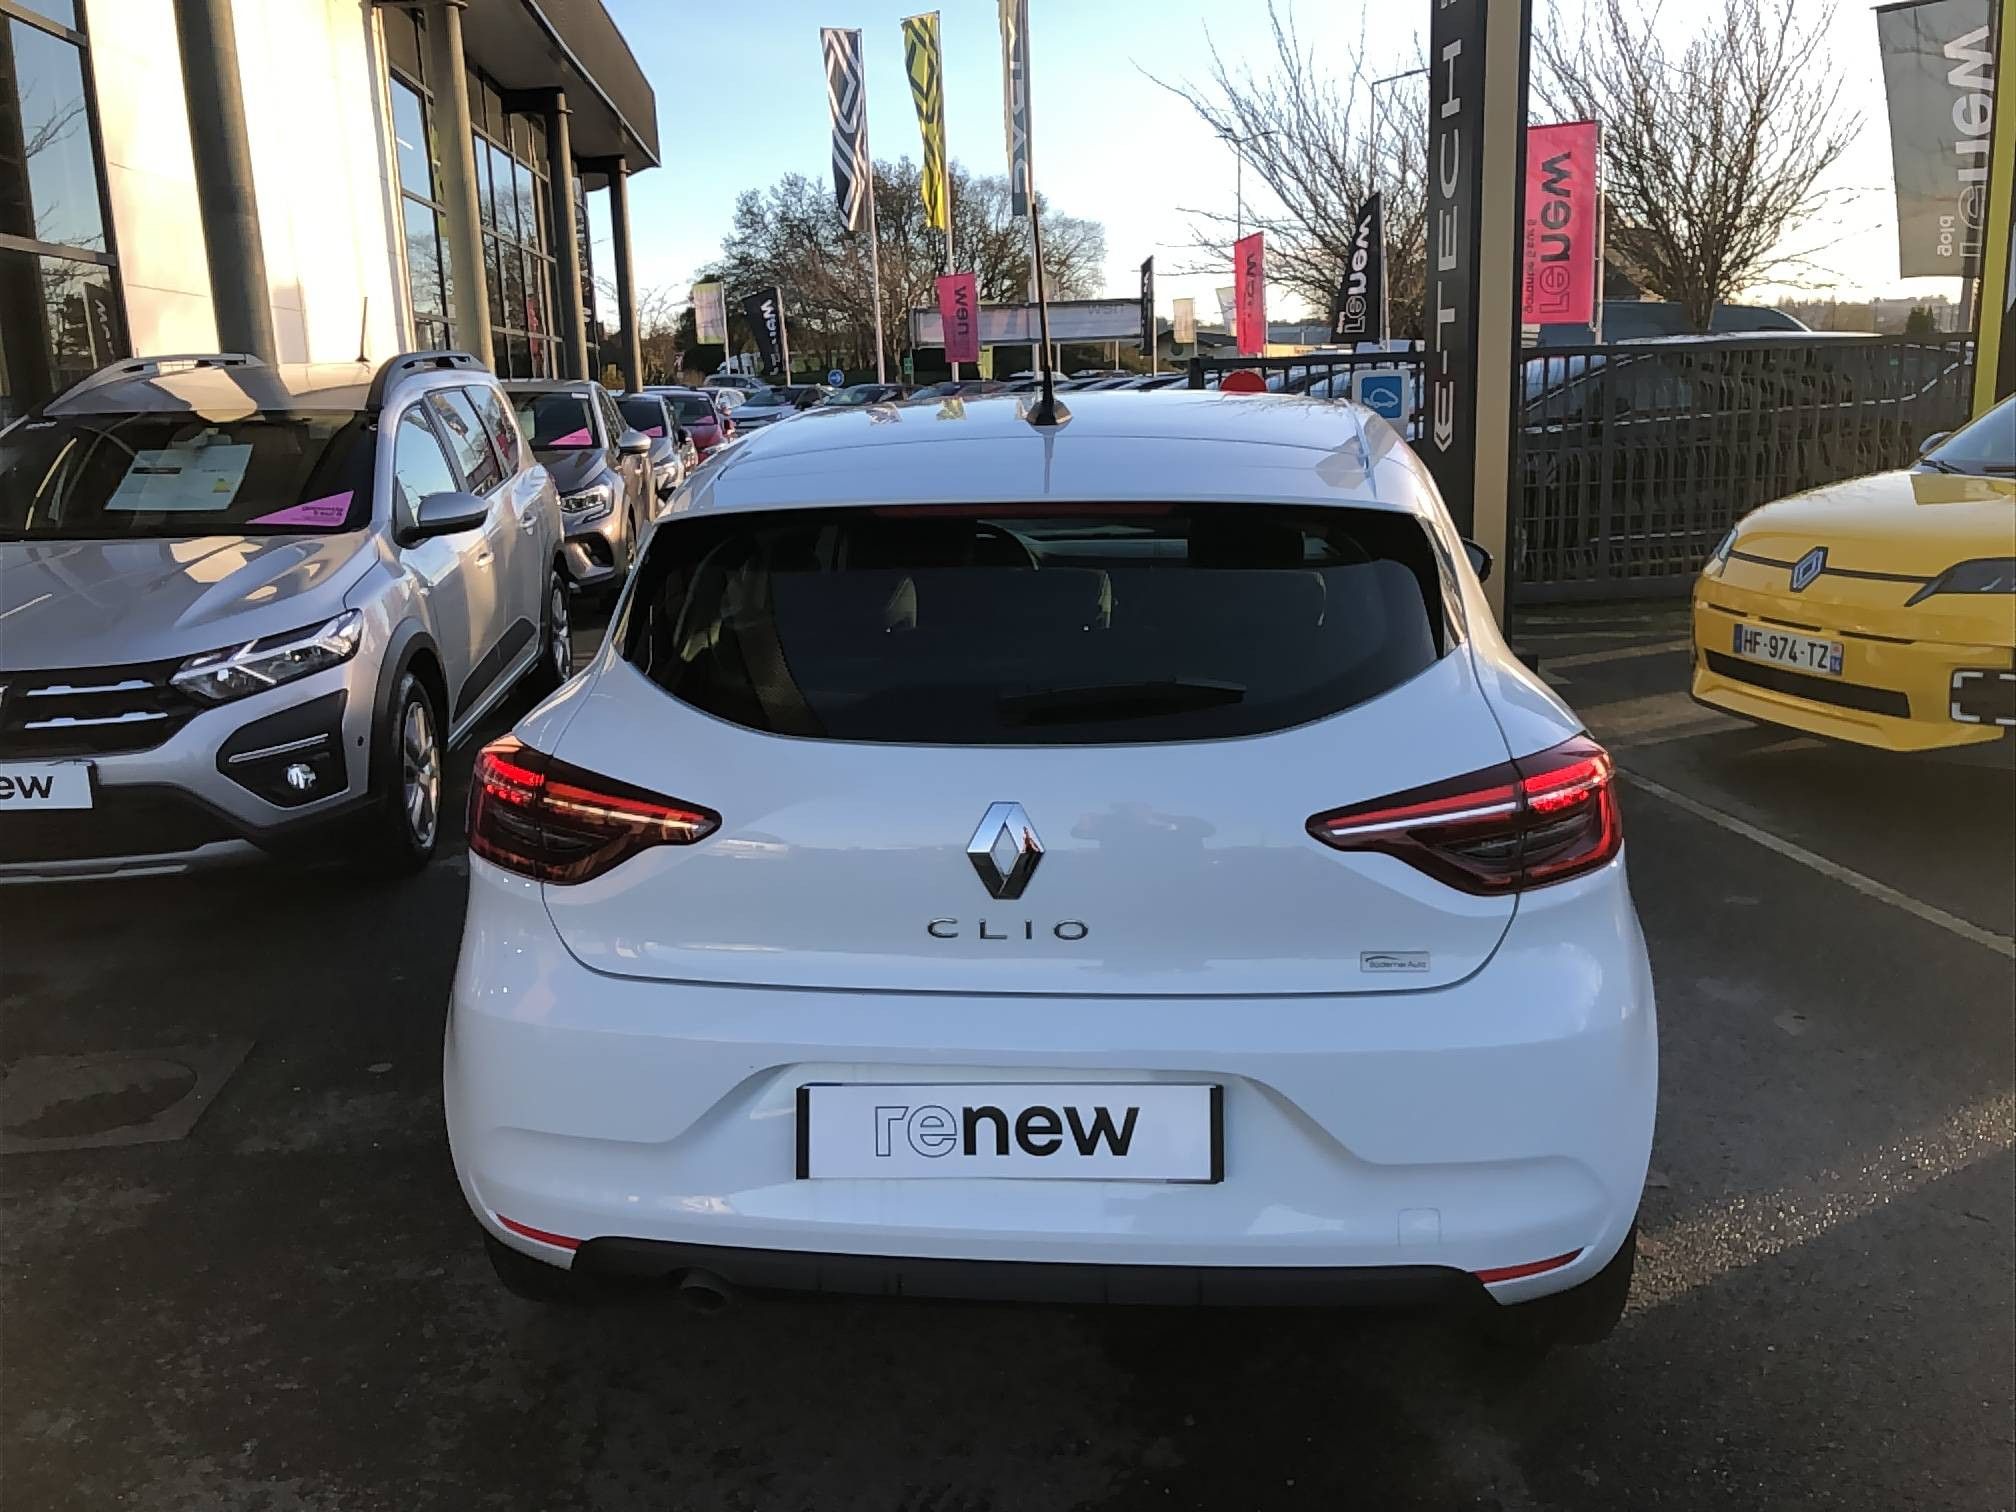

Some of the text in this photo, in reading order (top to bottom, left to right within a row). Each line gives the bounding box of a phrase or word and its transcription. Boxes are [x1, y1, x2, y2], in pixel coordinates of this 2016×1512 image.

[1433, 38, 1462, 452] E-TECH
[1743, 629, 1829, 670] HF-974-TZ
[927, 917, 1089, 941] CLIO
[874, 1104, 1141, 1158] renew
